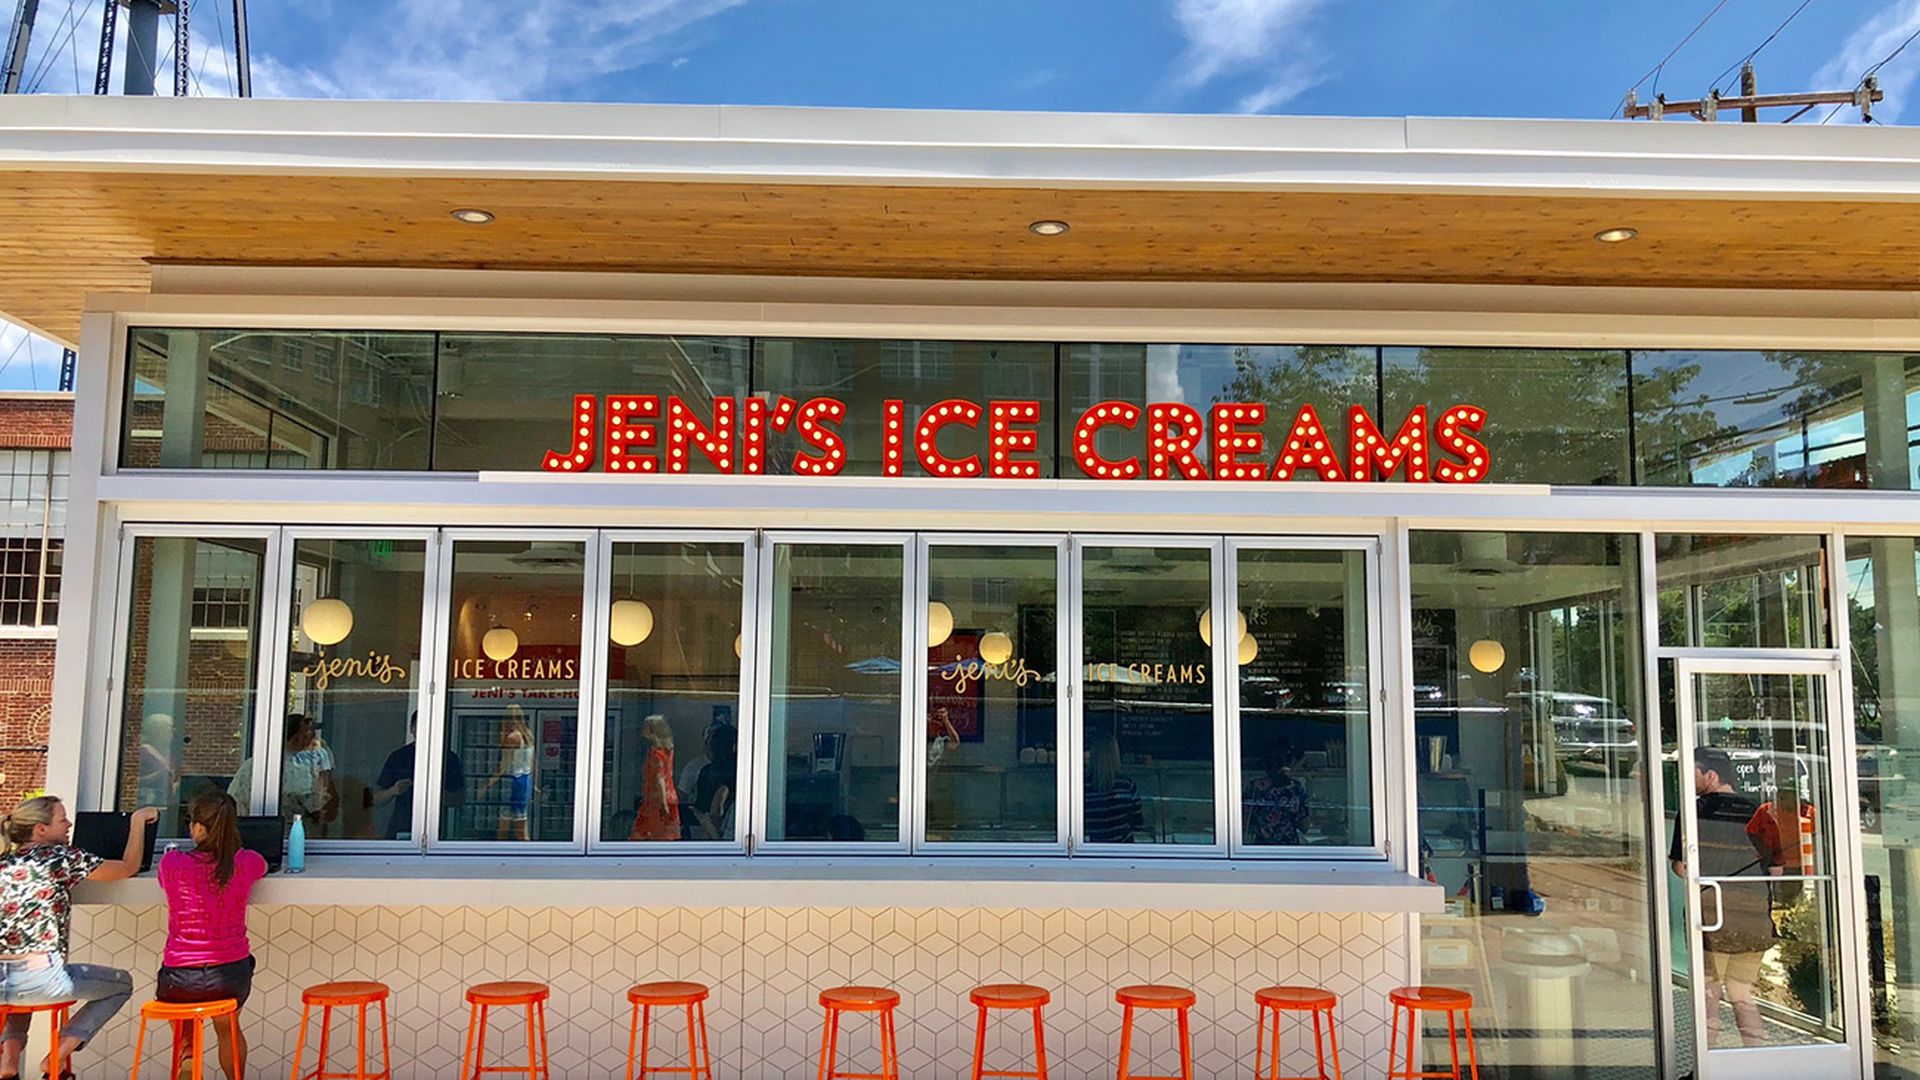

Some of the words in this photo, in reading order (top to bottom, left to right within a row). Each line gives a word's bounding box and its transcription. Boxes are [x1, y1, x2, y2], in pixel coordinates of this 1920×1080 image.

[541, 394, 847, 476] JENI'S
[882, 399, 1041, 479] ICE
[1073, 400, 1491, 483] CREAMS
[303, 650, 406, 690] jeni's
[454, 659, 485, 678] ICE
[495, 659, 575, 679] CREAMS
[941, 654, 1041, 694] jeni's
[1088, 663, 1118, 682] ICE
[1127, 663, 1207, 684] CREAMS
[1736, 764, 1755, 779] open
